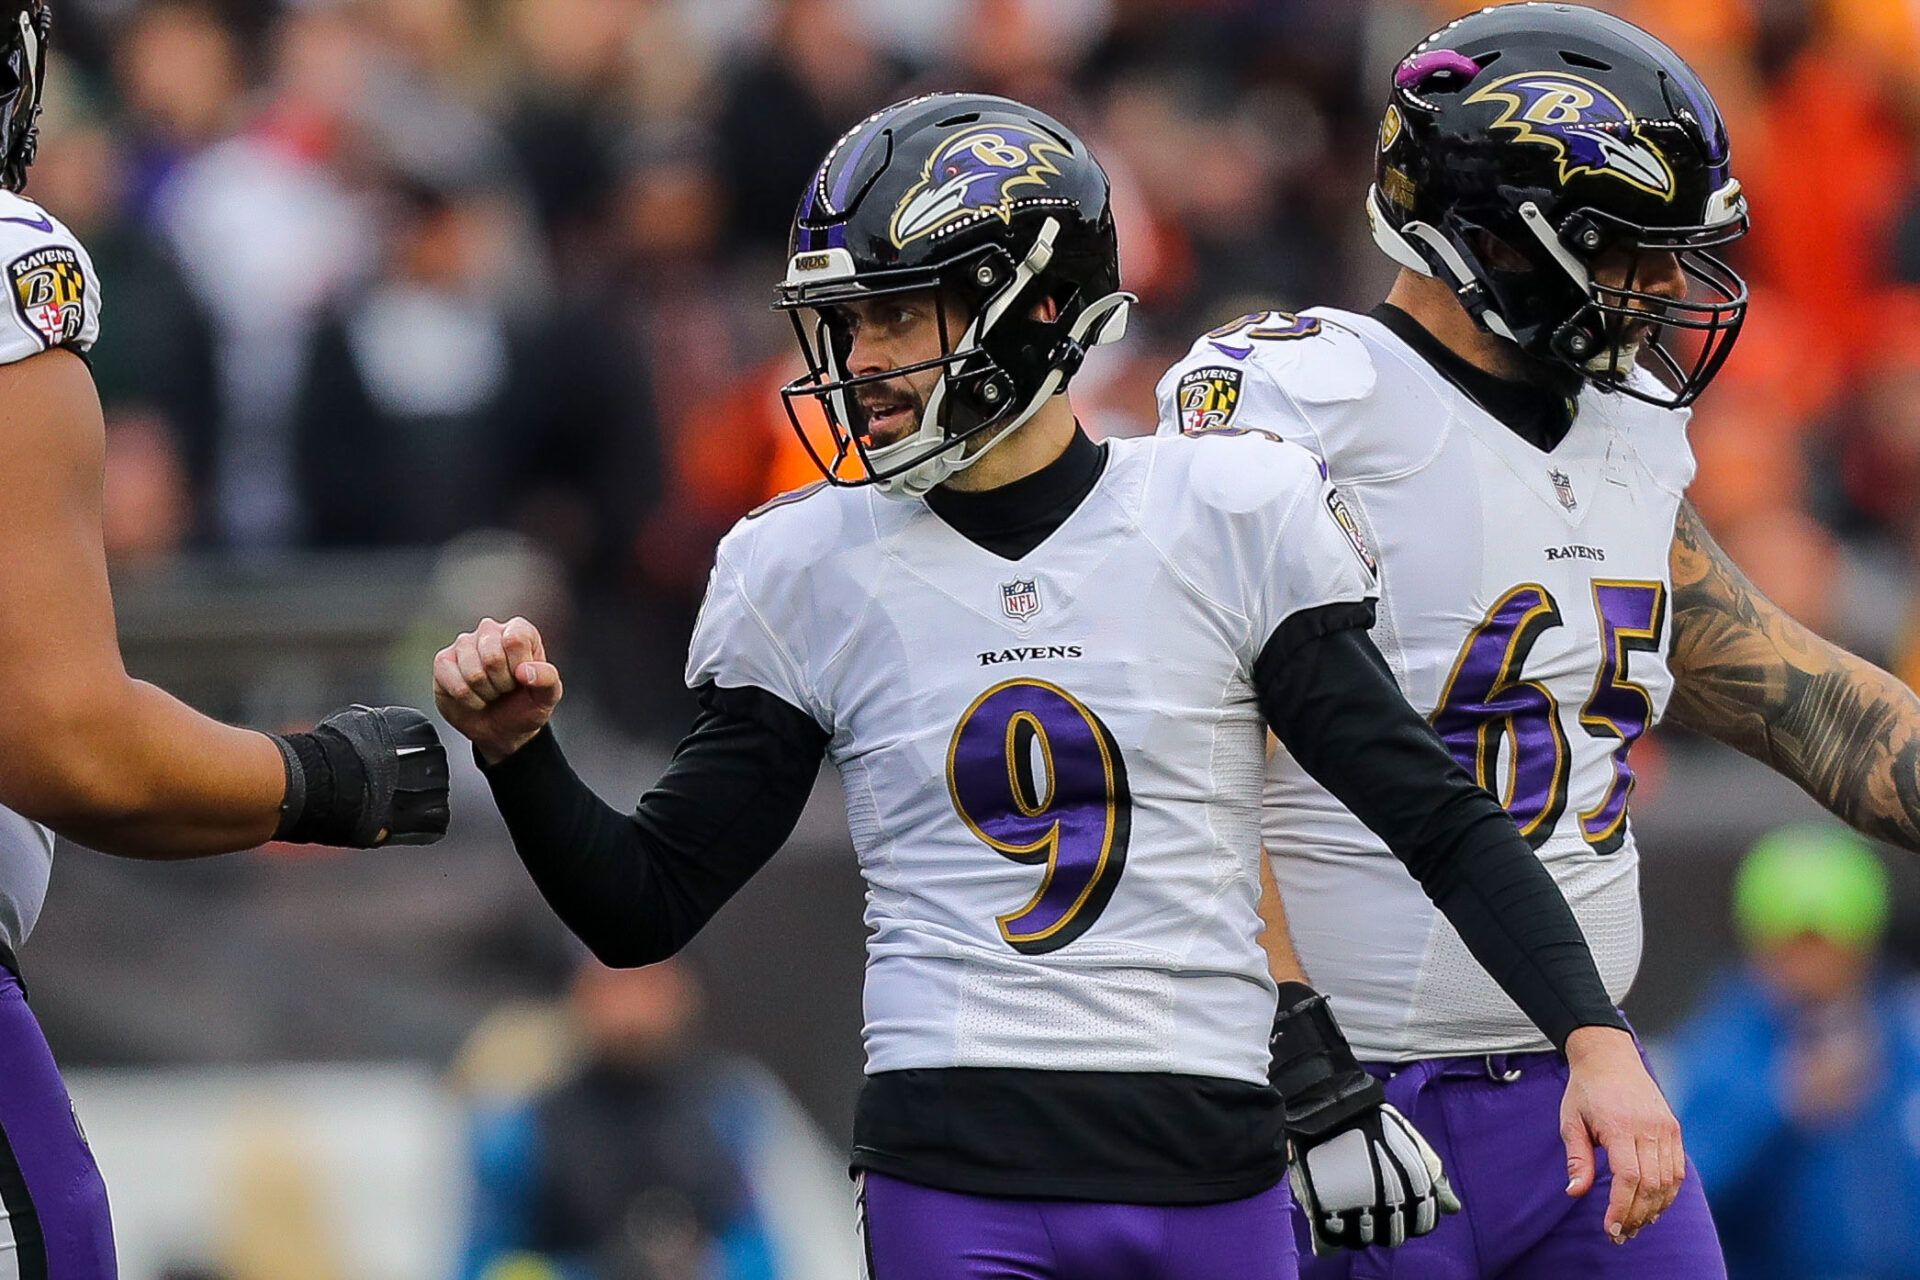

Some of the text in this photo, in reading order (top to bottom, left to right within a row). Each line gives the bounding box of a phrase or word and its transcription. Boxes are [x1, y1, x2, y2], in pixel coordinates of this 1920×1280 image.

[1517, 82, 1594, 124] B
[943, 133, 1028, 168] B
[14, 250, 75, 276] RAVENS
[1183, 369, 1238, 385] RAVENS
[1544, 545, 1605, 561] RAVENS
[1008, 593, 1036, 612] NFL
[976, 646, 1082, 666] RAVENS
[1430, 578, 1667, 856] 65
[946, 677, 1132, 955] 9
